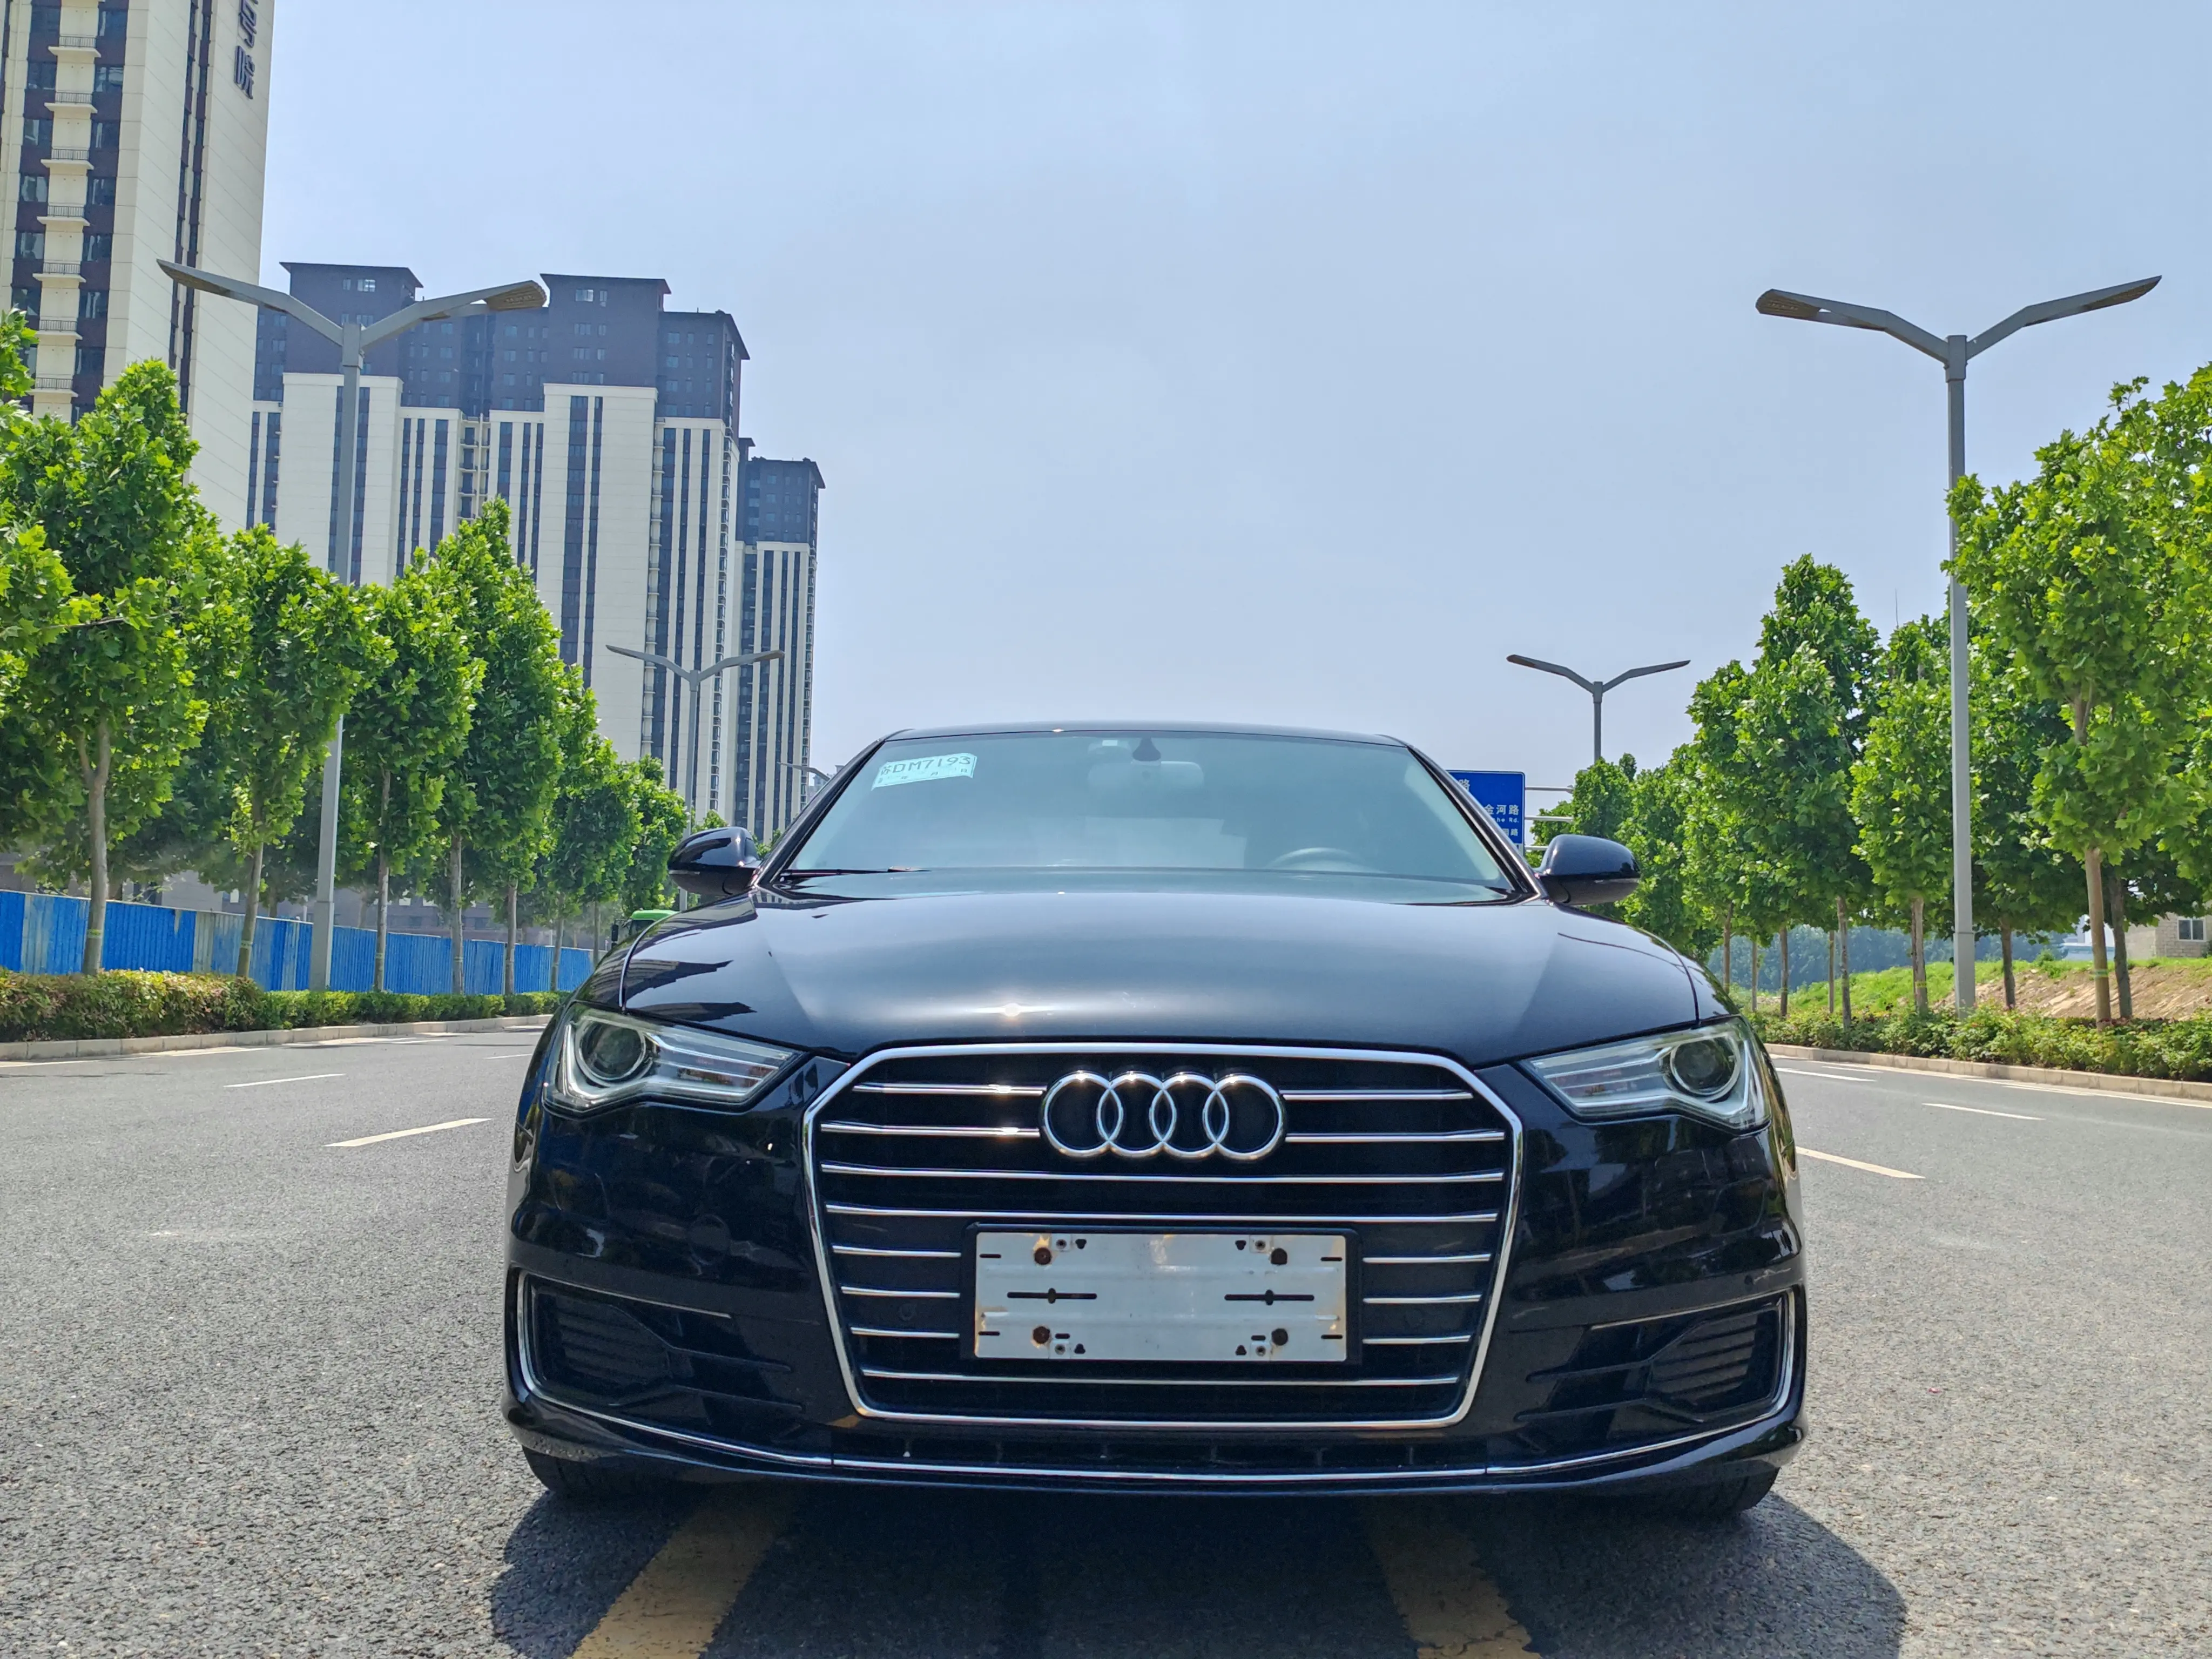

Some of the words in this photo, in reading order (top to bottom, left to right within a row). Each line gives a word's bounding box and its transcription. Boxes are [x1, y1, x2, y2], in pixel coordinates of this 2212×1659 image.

[234, 0, 258, 99] 号院
[1484, 804, 1519, 815] 金河路
